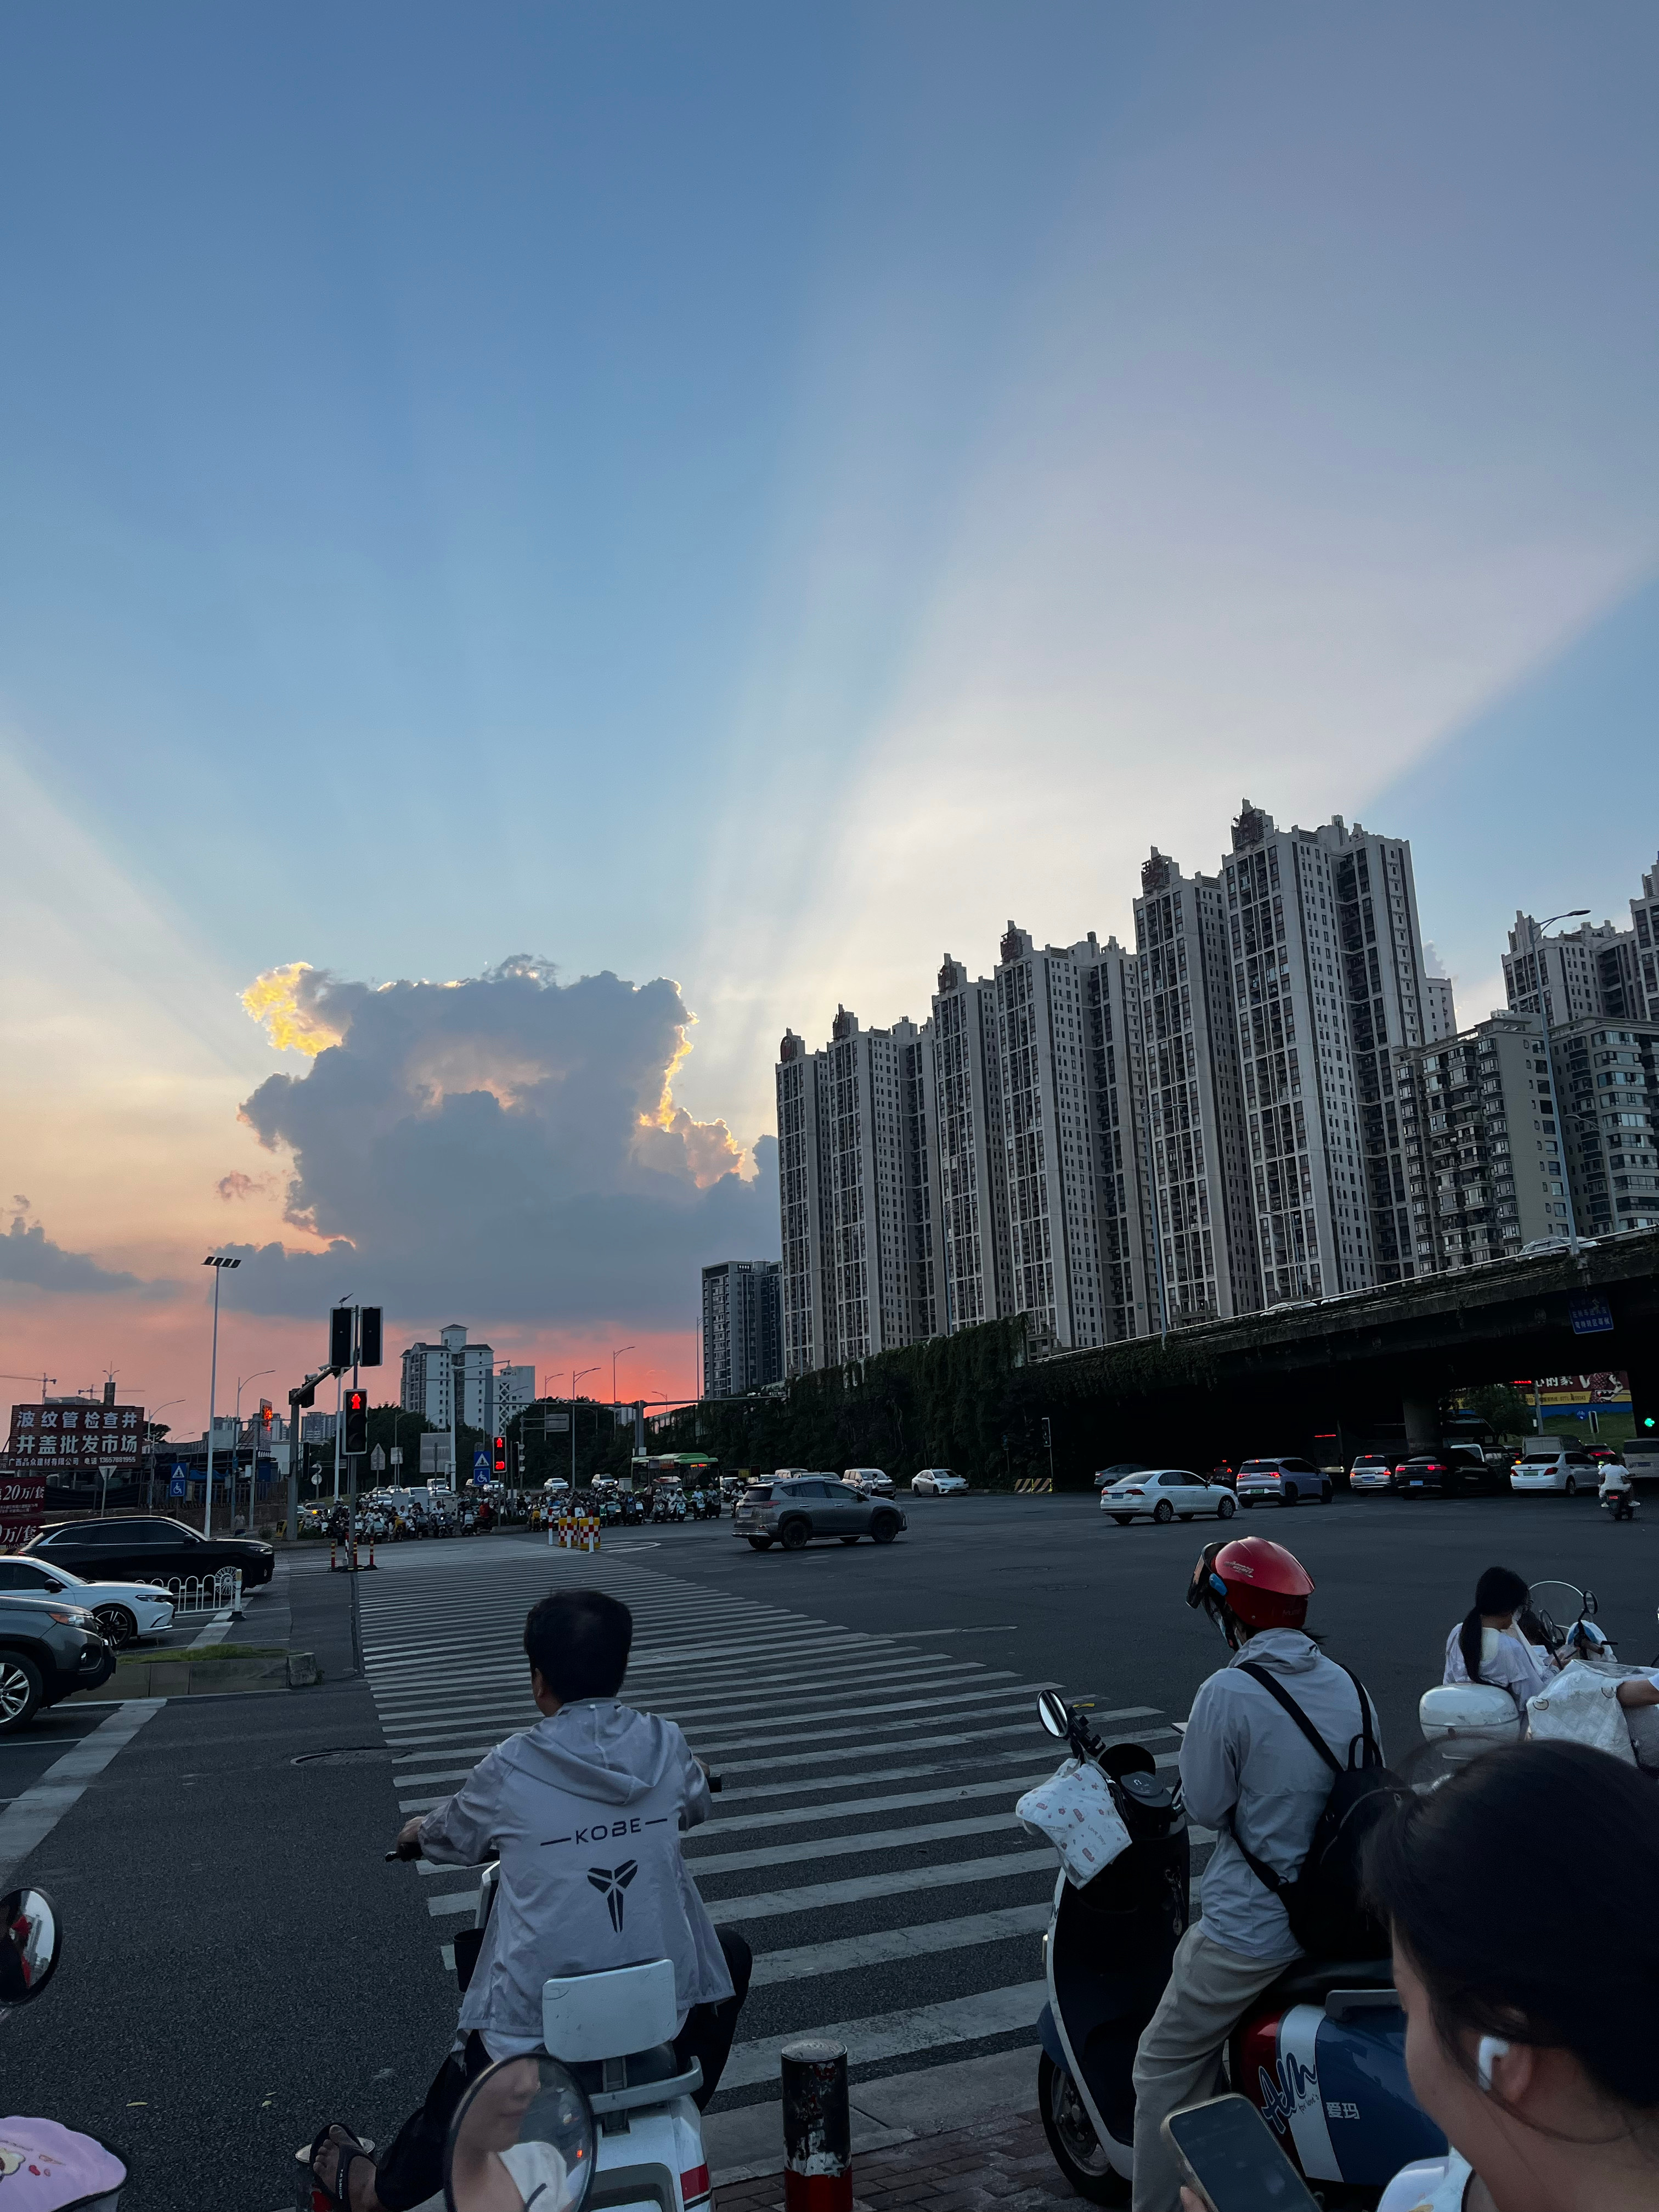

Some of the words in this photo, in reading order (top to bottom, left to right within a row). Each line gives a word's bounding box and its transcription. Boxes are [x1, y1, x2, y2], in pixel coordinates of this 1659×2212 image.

[16, 1411, 137, 1429] 波纹管检查井
[16, 1435, 137, 1454] 井盖批发市场
[8, 1458, 79, 1466] 广西品众建材有限公司
[0, 1484, 45, 1500] 20万/套
[575, 1818, 641, 1844] KOBE
[1326, 2102, 1361, 2119] 爱玛
